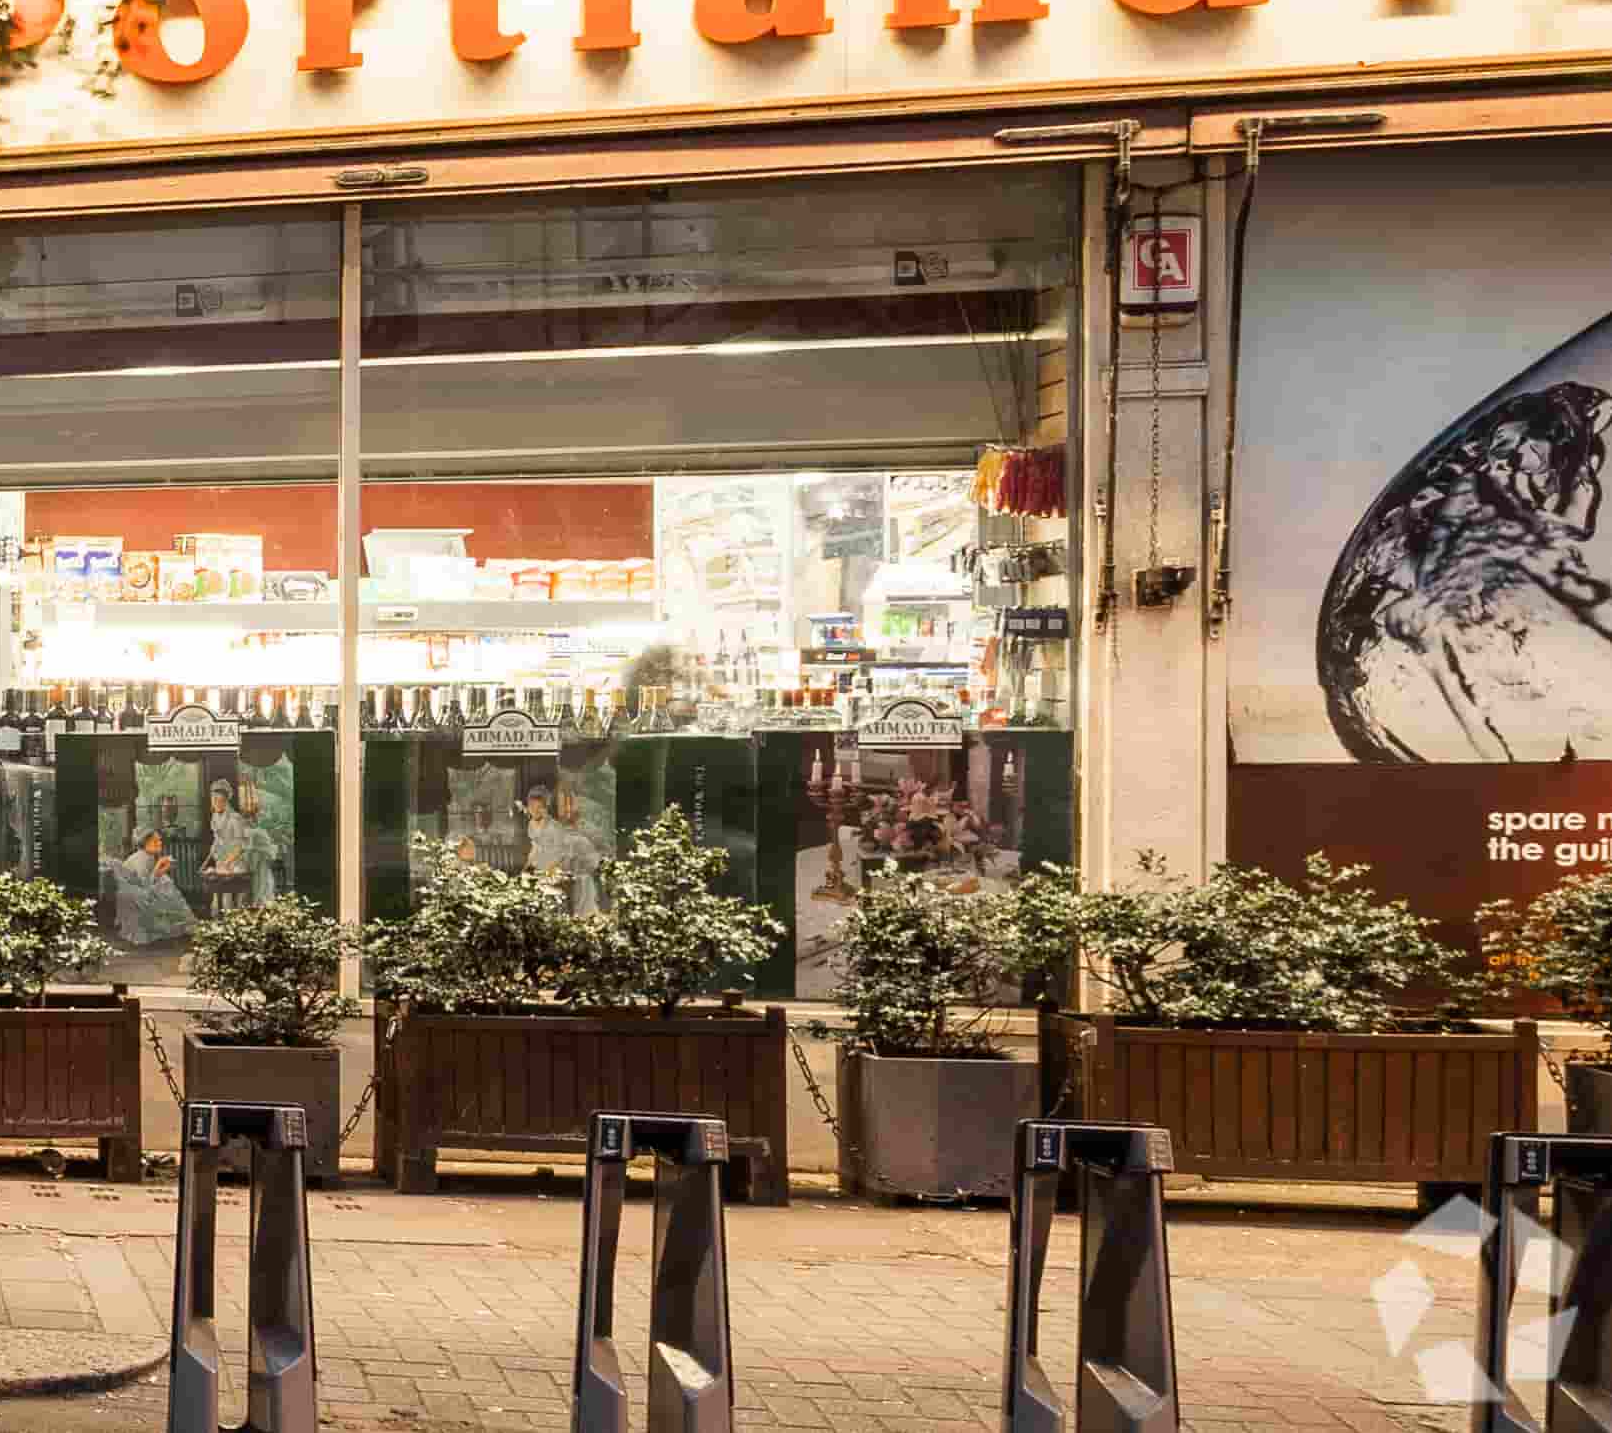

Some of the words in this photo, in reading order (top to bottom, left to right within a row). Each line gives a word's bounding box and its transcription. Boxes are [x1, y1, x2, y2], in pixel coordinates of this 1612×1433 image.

[207, 723, 236, 737] TEA
[864, 721, 925, 734] AHMAD
[928, 720, 960, 734] TEA
[466, 730, 524, 742] AHMAD
[526, 730, 557, 742] TEA
[1487, 810, 1587, 836] spare
[1487, 836, 1546, 861] the
